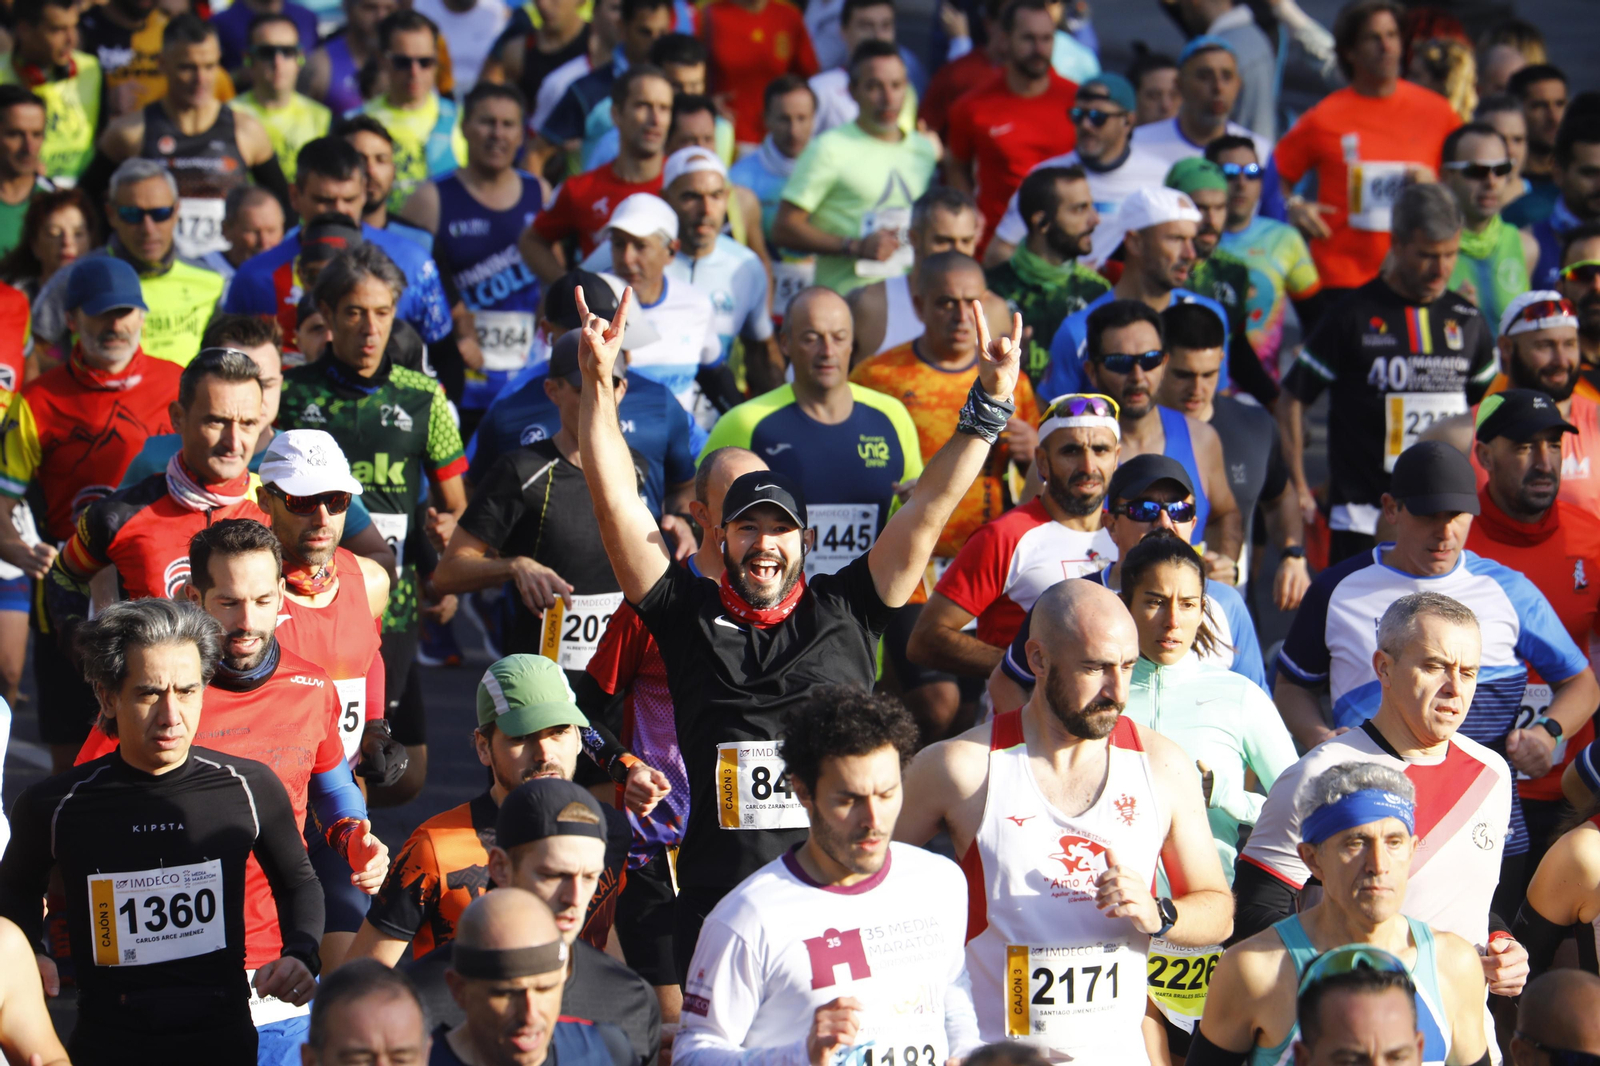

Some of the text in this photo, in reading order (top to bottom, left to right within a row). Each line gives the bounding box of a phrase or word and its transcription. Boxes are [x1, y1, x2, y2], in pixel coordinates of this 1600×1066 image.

[1368, 356, 1408, 390] 40
[811, 524, 871, 553] 1445
[577, 597, 612, 607] IMDECO
[723, 776, 733, 810] CAJÓN
[751, 766, 793, 800] 84
[132, 823, 184, 833] KIPSTA
[130, 873, 180, 888] IMDECO
[588, 866, 617, 912] RAIL
[119, 888, 216, 935] 1360
[864, 916, 939, 941] 35 MEDIA
[98, 912, 111, 947] CAJÓN
[136, 936, 160, 944] CARLOS
[161, 933, 178, 941] ARCE
[827, 937, 842, 949] 35
[1045, 946, 1093, 957] IMDECO
[1031, 962, 1119, 1005] 2171
[1147, 954, 1220, 990] 2226
[1014, 977, 1023, 1015] CAJÓN
